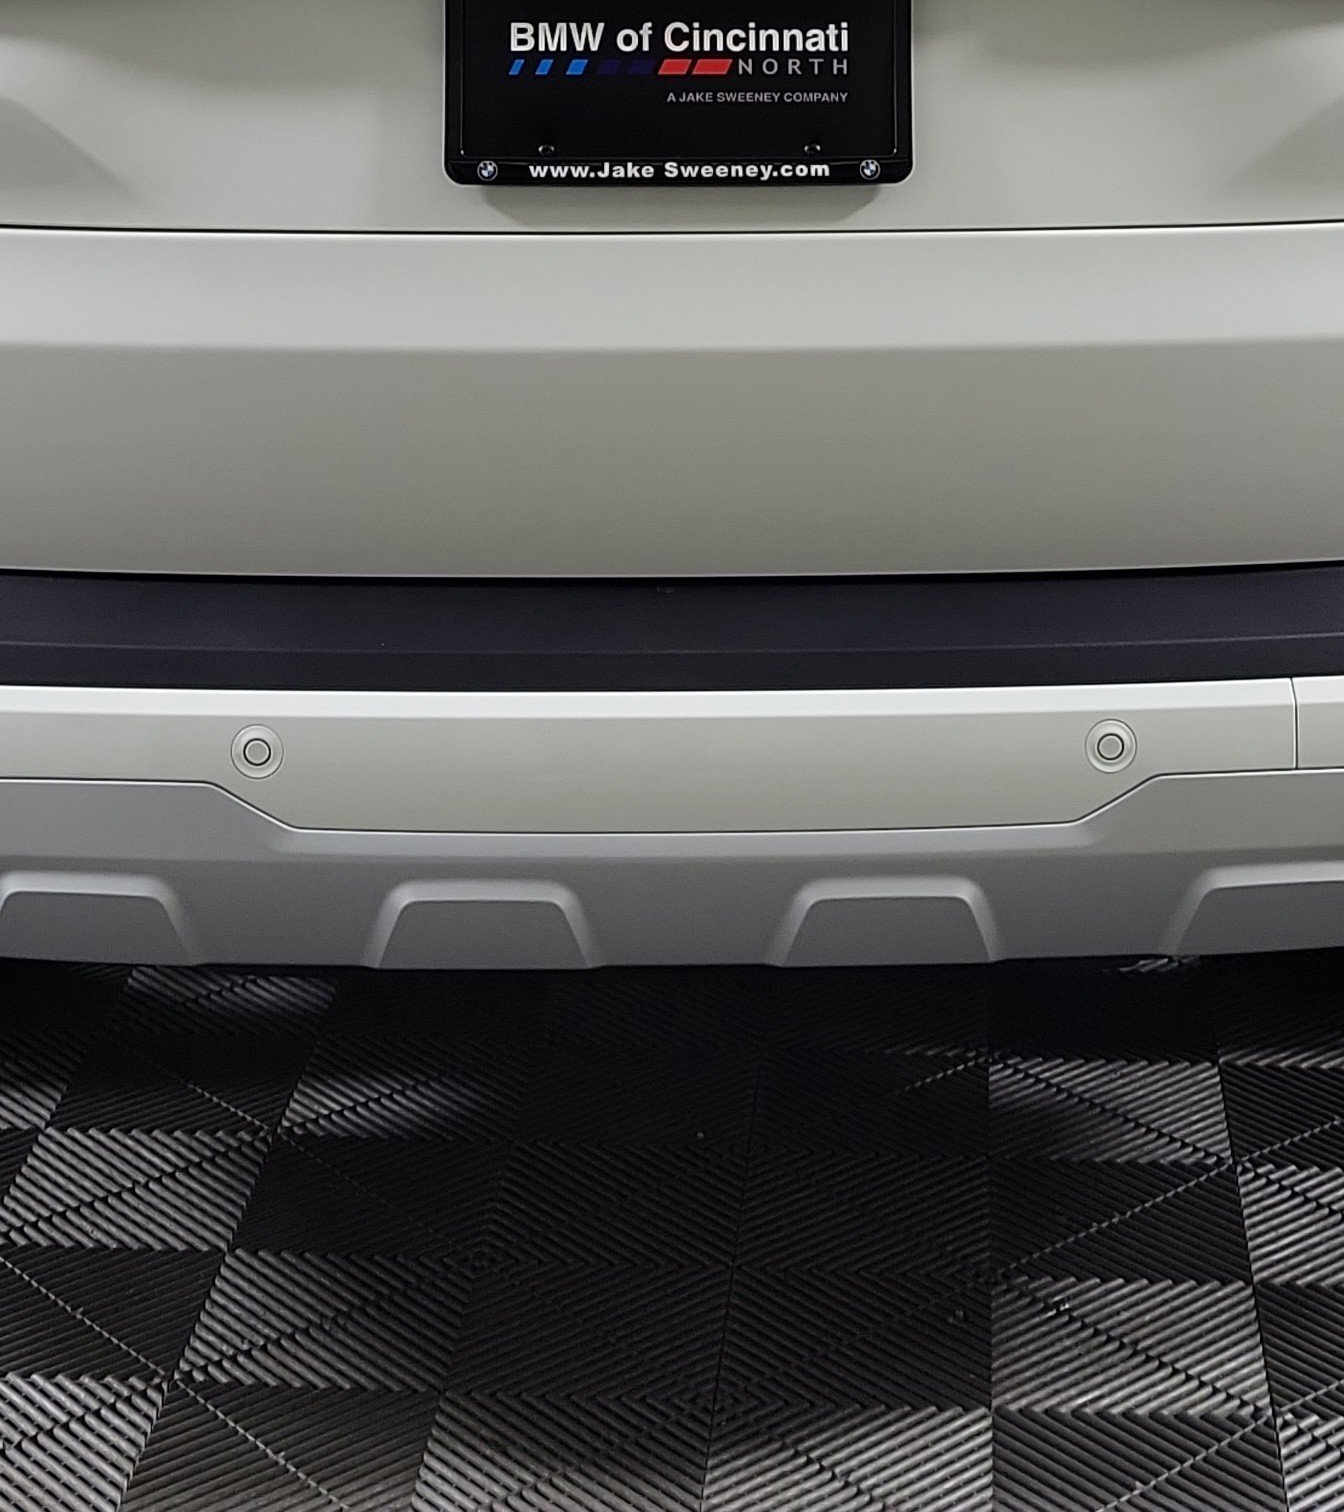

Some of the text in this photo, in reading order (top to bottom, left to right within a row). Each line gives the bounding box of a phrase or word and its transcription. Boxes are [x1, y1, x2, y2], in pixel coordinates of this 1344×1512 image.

[510, 21, 849, 52] BMW of Cincinnati
[737, 58, 848, 75] NORTH
[666, 92, 849, 103] A JAKE SWEENEY COMPANY
[529, 162, 831, 181] www.Jake Sweeney.com
